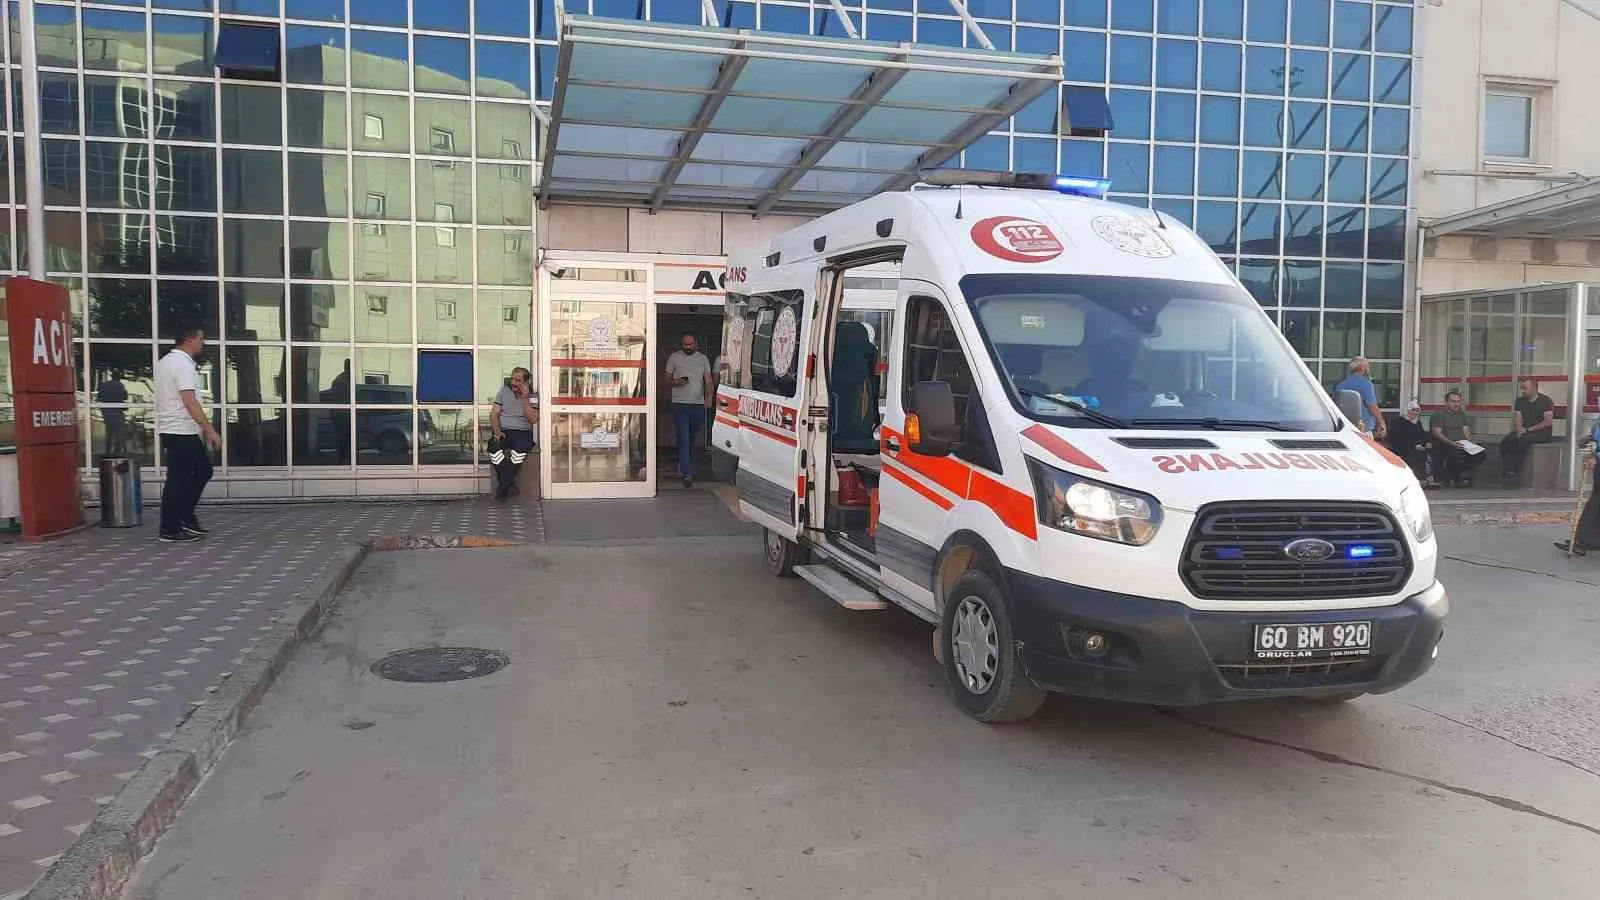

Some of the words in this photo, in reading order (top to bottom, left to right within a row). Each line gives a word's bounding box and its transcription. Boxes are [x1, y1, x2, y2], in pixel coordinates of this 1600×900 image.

[1007, 226, 1049, 240] 112
[739, 396, 783, 426] AMBULANS
[1261, 627, 1288, 649] 60
[1297, 625, 1324, 648] BM
[1332, 624, 1368, 647] 920
